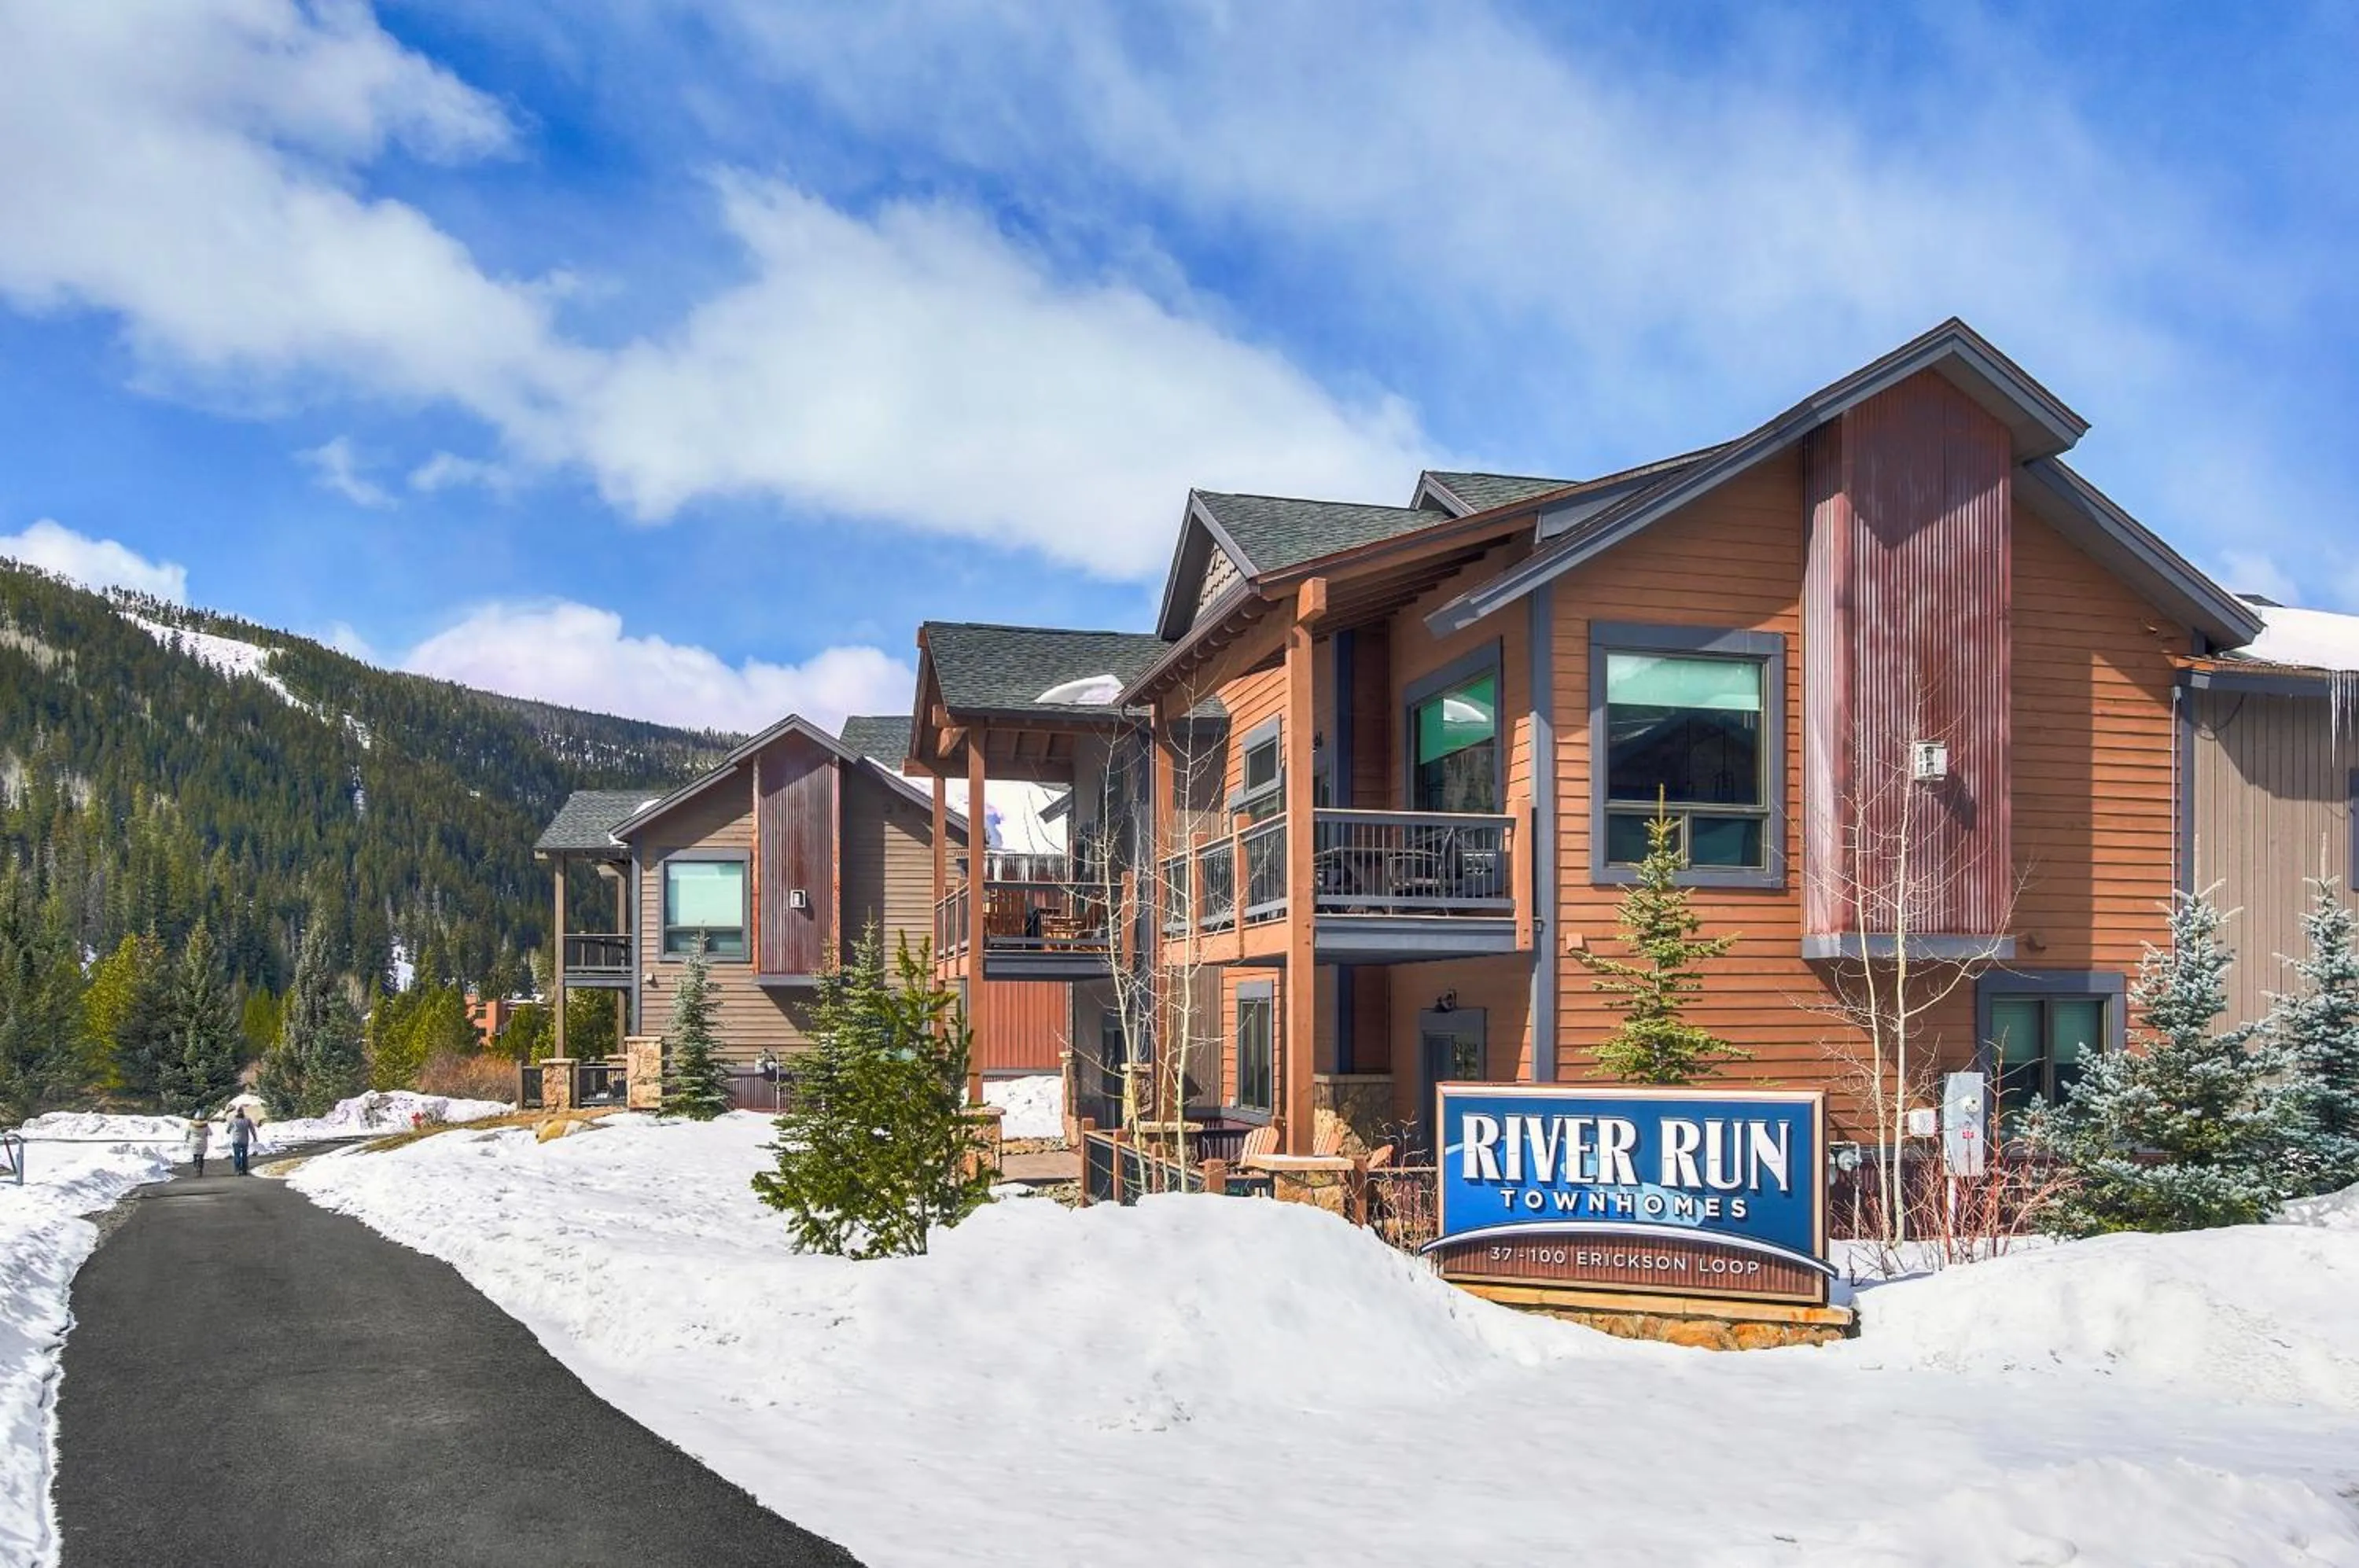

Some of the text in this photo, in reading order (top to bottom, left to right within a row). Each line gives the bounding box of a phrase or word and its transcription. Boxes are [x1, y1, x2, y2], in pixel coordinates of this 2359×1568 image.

[1463, 1113, 1790, 1191] RIVER RUN
[1500, 1189, 1747, 1217] TOWNHOMES
[1577, 1251, 1686, 1271] ERICKSON
[1699, 1258, 1760, 1275] LOOP
